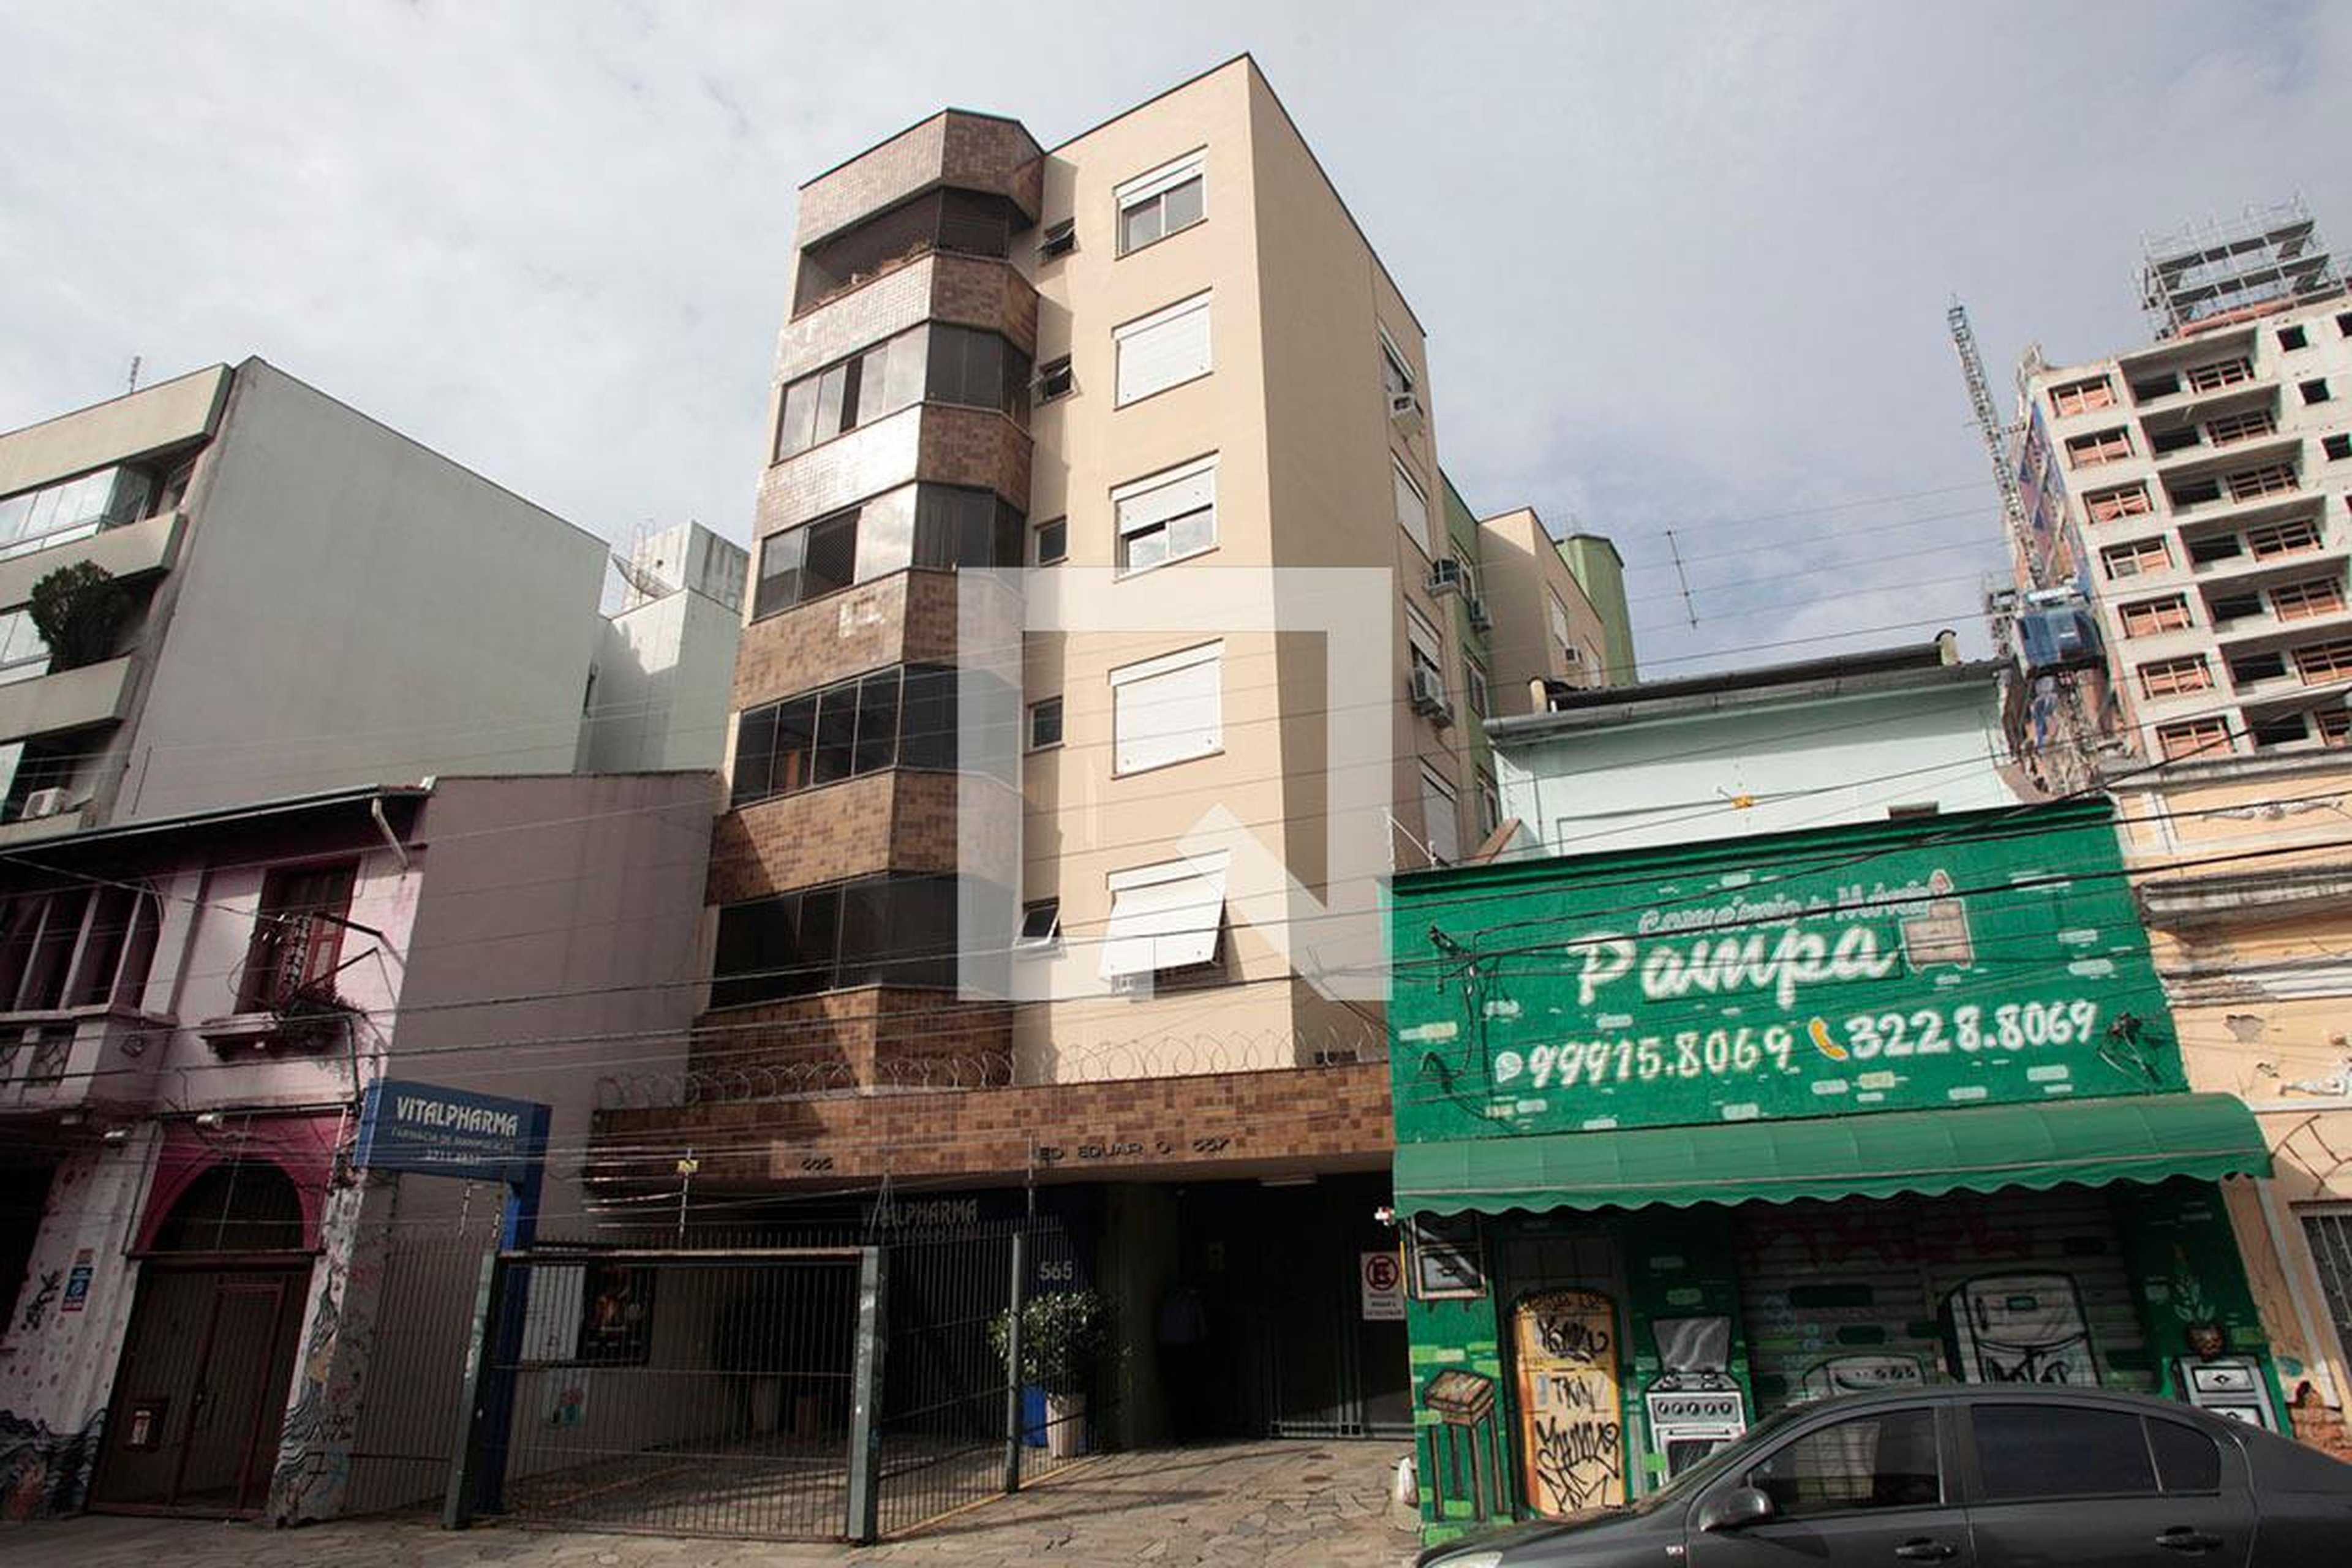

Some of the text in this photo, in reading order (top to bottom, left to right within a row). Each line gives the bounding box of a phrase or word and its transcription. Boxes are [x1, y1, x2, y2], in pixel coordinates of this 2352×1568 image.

[1566, 926, 1900, 1010] Pampa
[1844, 999, 2097, 1061] 3228.8069
[397, 1096, 519, 1137] VITALPHARMA
